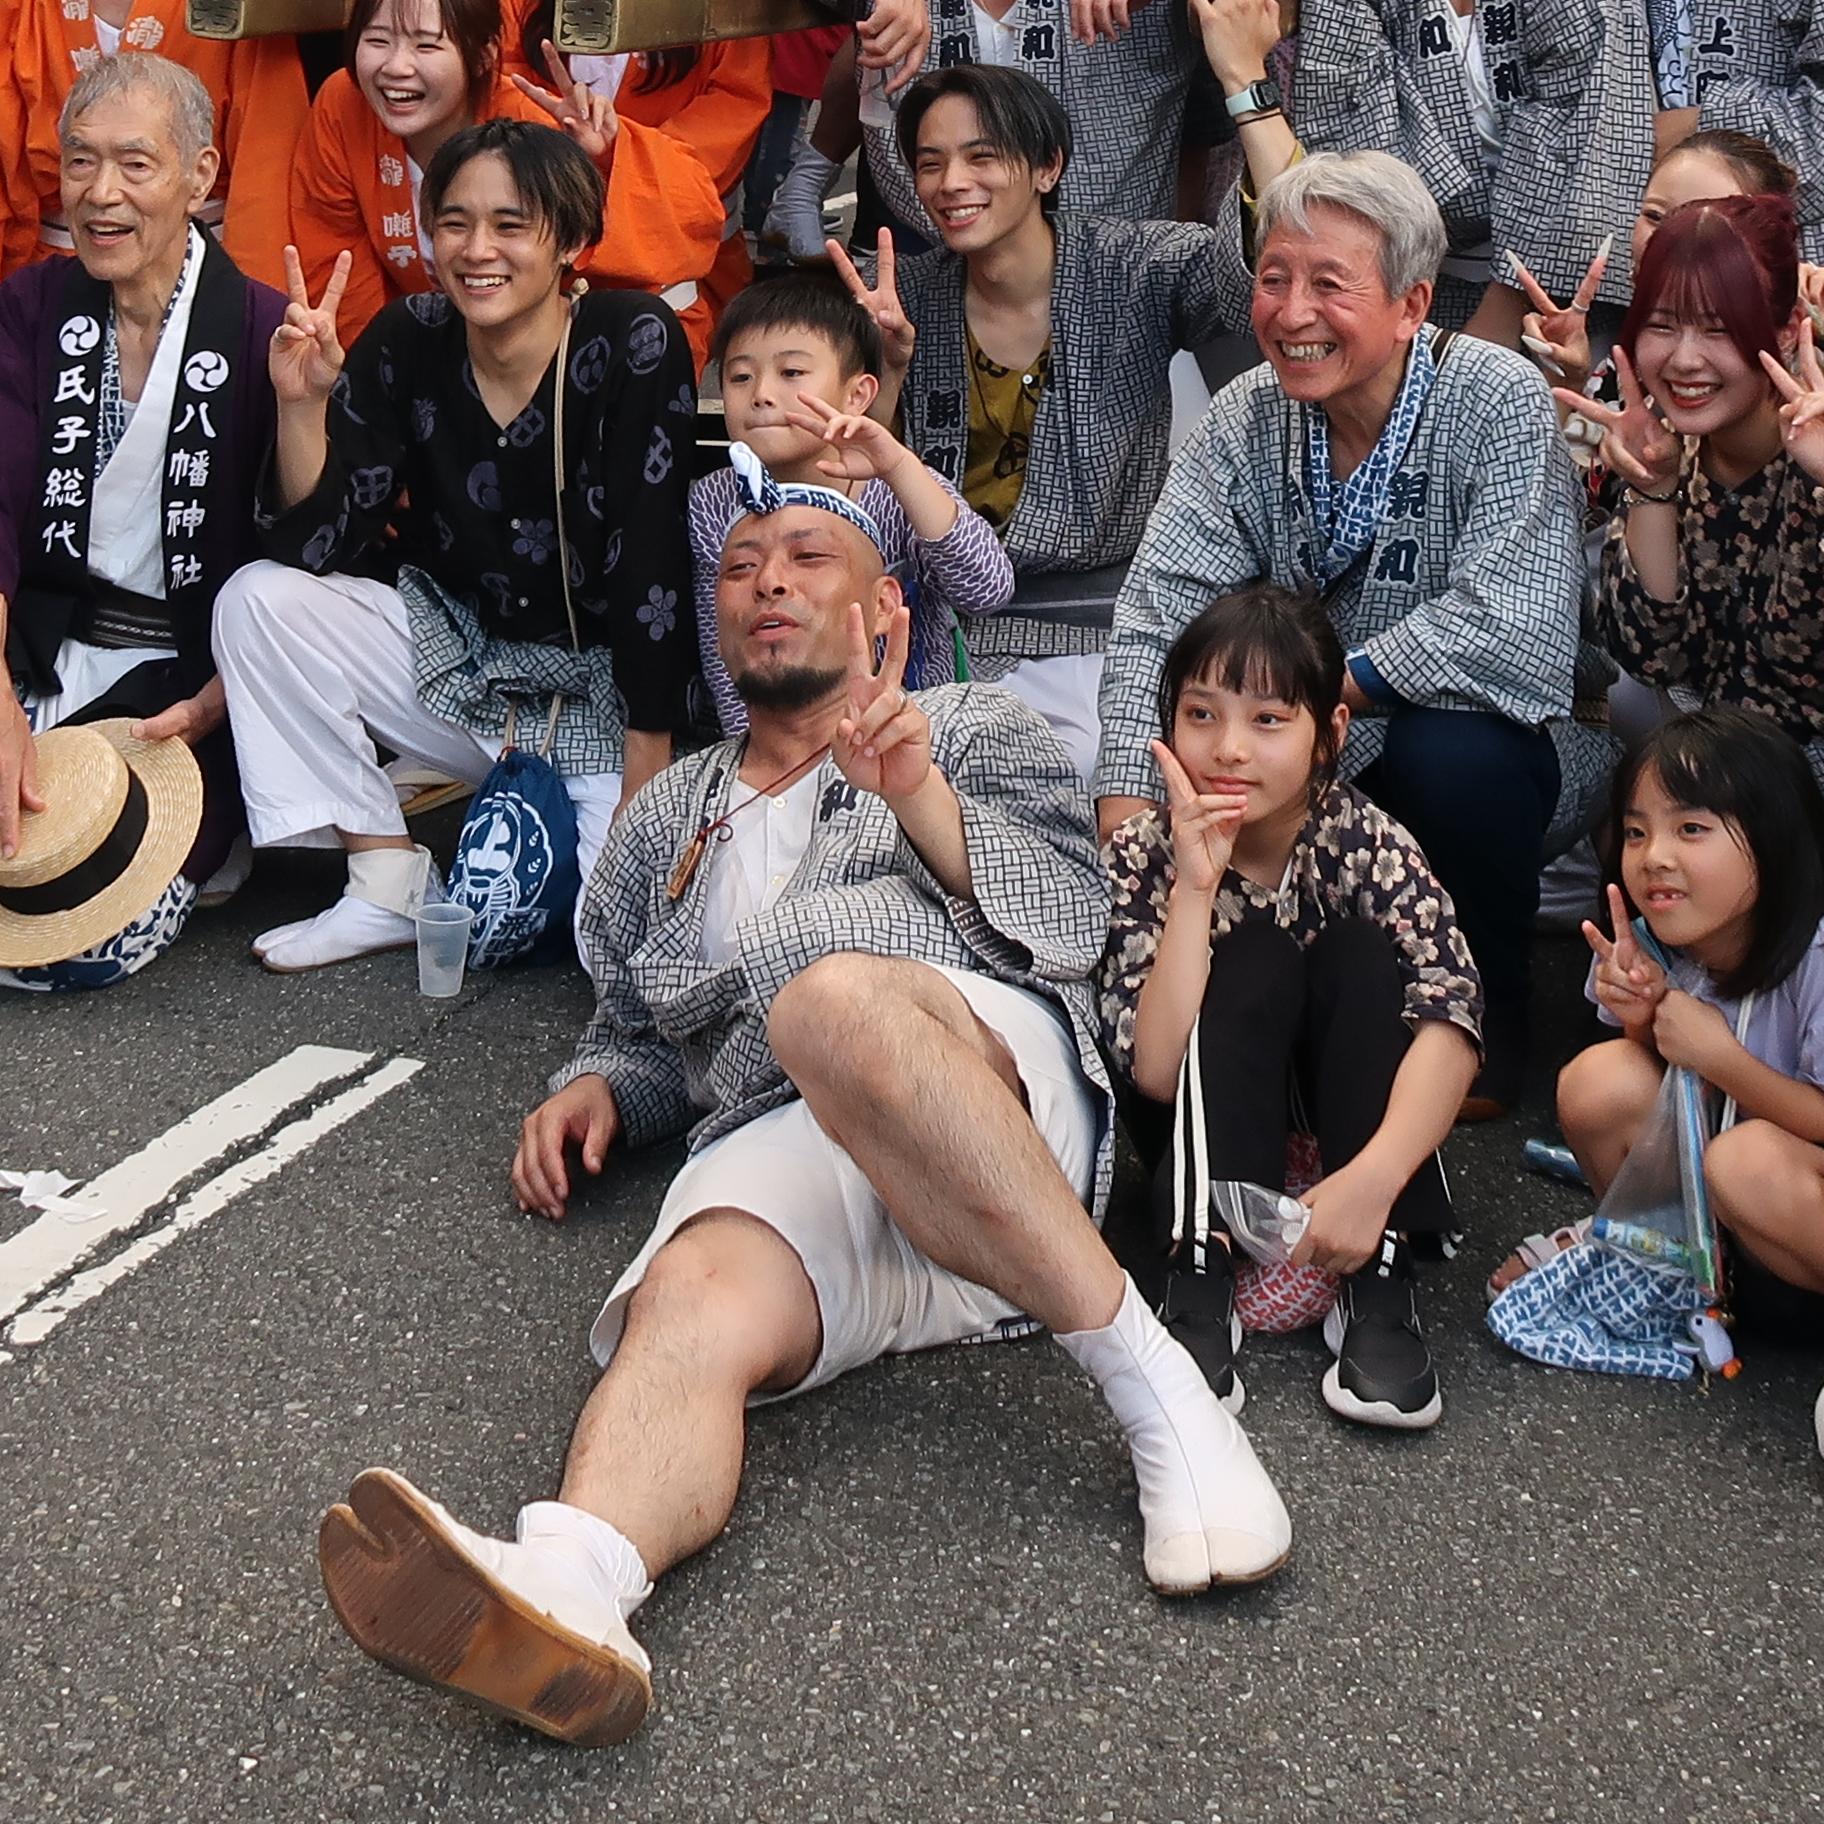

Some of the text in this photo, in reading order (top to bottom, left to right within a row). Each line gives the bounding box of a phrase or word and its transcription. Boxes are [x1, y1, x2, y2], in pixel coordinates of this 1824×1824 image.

[42, 364, 96, 559] 氏子総代
[166, 400, 217, 590] 八幡神社
[1375, 471, 1430, 585] 親和
